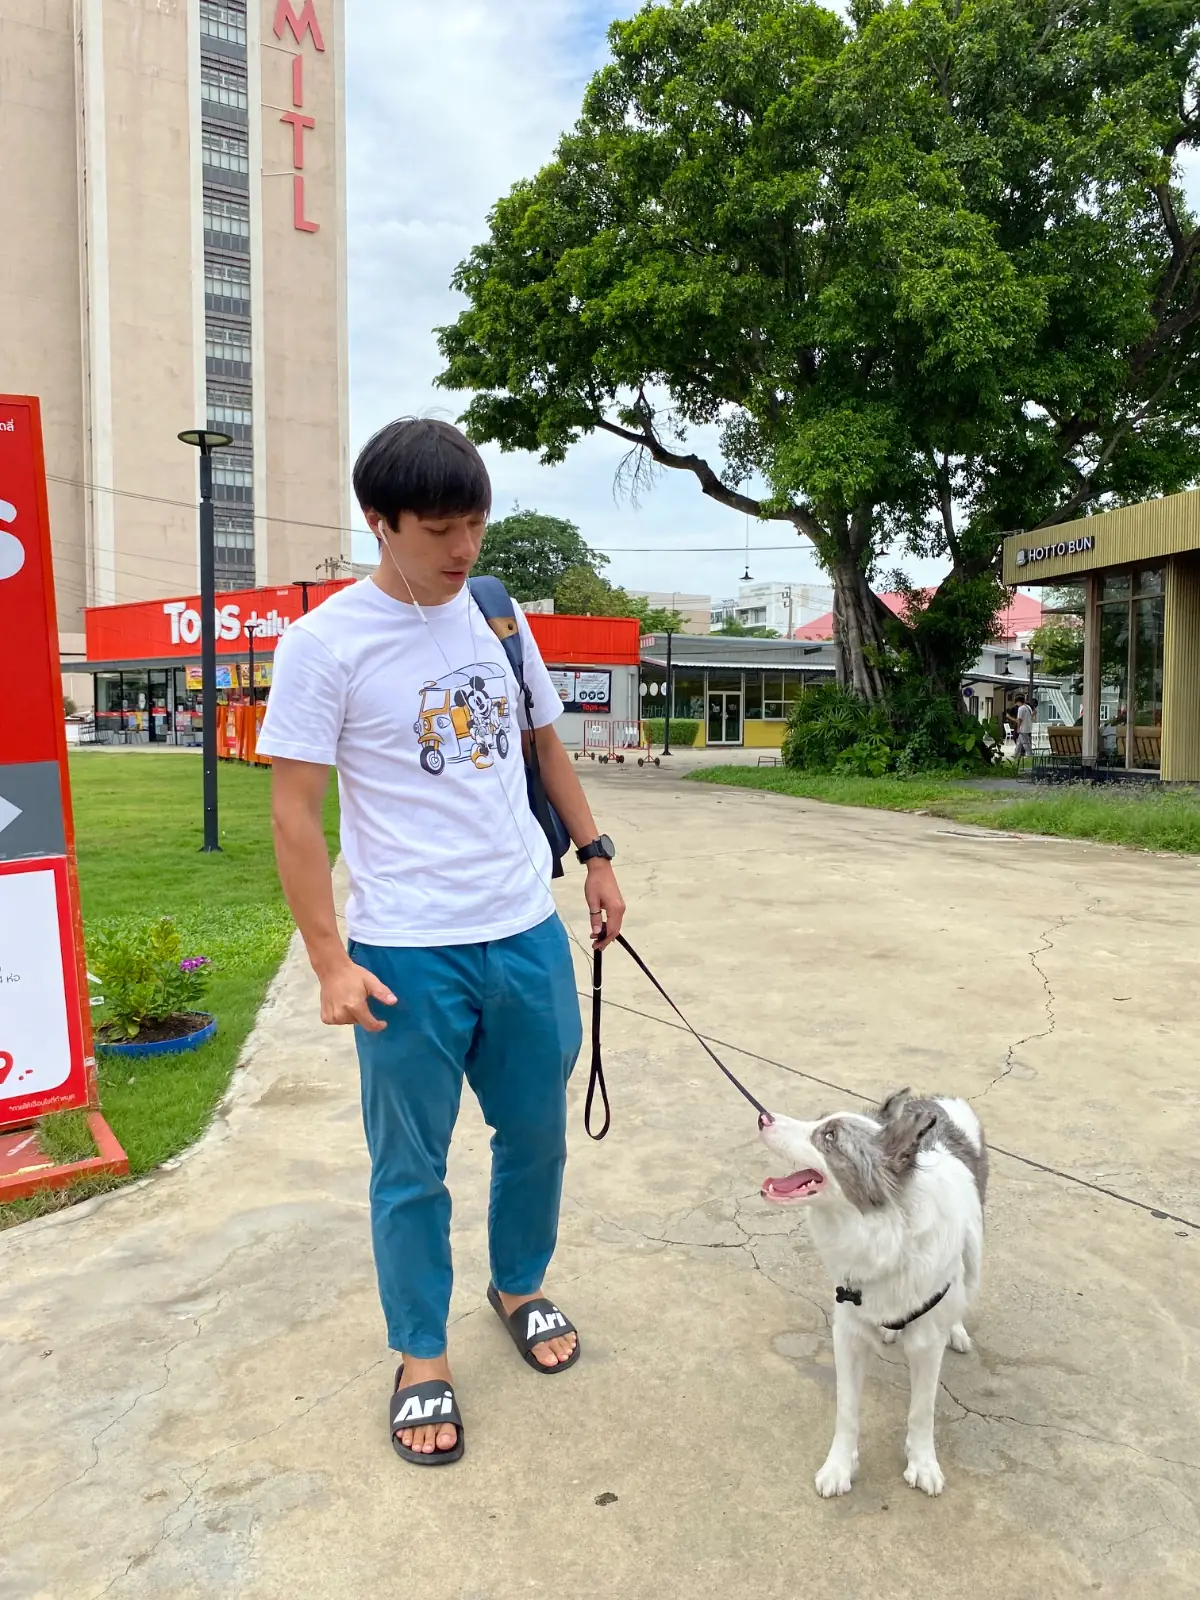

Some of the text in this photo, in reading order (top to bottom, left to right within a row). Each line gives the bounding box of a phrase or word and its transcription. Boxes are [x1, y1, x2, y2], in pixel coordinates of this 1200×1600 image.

[1029, 537, 1092, 561] HOTTO BUN
[526, 1306, 567, 1341] Ari
[393, 1390, 453, 1424] Ari
